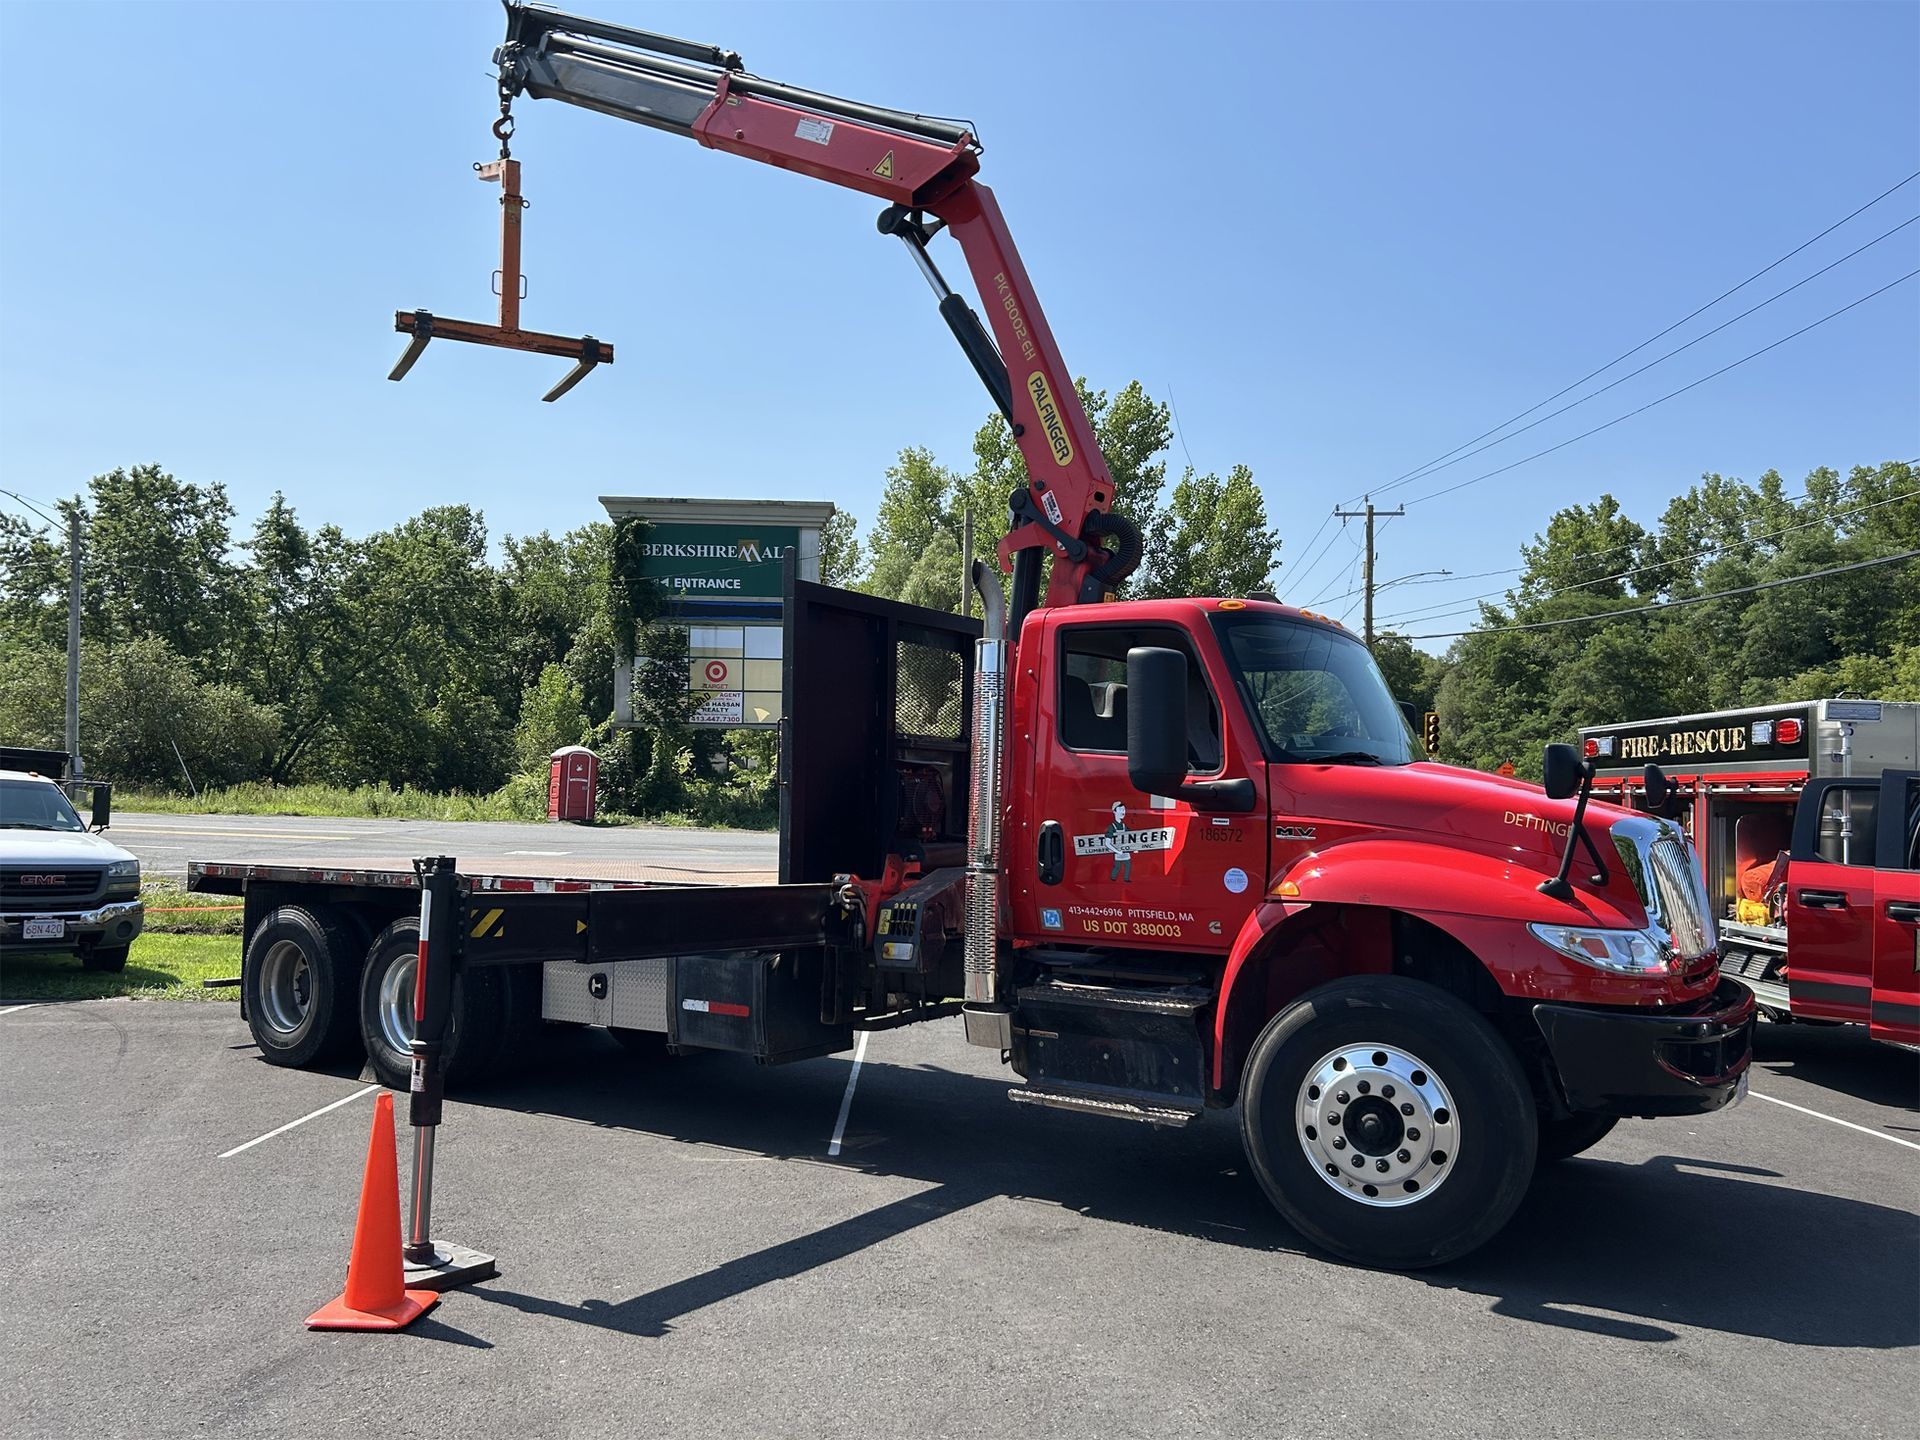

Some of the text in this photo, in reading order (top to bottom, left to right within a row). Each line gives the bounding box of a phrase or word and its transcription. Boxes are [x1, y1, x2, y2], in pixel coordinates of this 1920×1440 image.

[994, 272, 1009, 294] PK
[1030, 375, 1070, 461] PALFINGER
[642, 543, 784, 562] BERKSHIRE MAL
[674, 577, 741, 589] ENTRANCE
[1621, 726, 1746, 759] FIRE RESCUE
[1275, 826, 1316, 838] MV
[1504, 811, 1572, 838] DETTINGE
[1078, 830, 1168, 848] DETTINGER
[1199, 827, 1243, 842] 186572
[20, 874, 66, 885] GMC
[1128, 908, 1177, 922] PITTSFIELD,
[1178, 912, 1195, 922] MA
[25, 923, 63, 935] 68N 420
[1082, 919, 1182, 938] US DOT 389003
